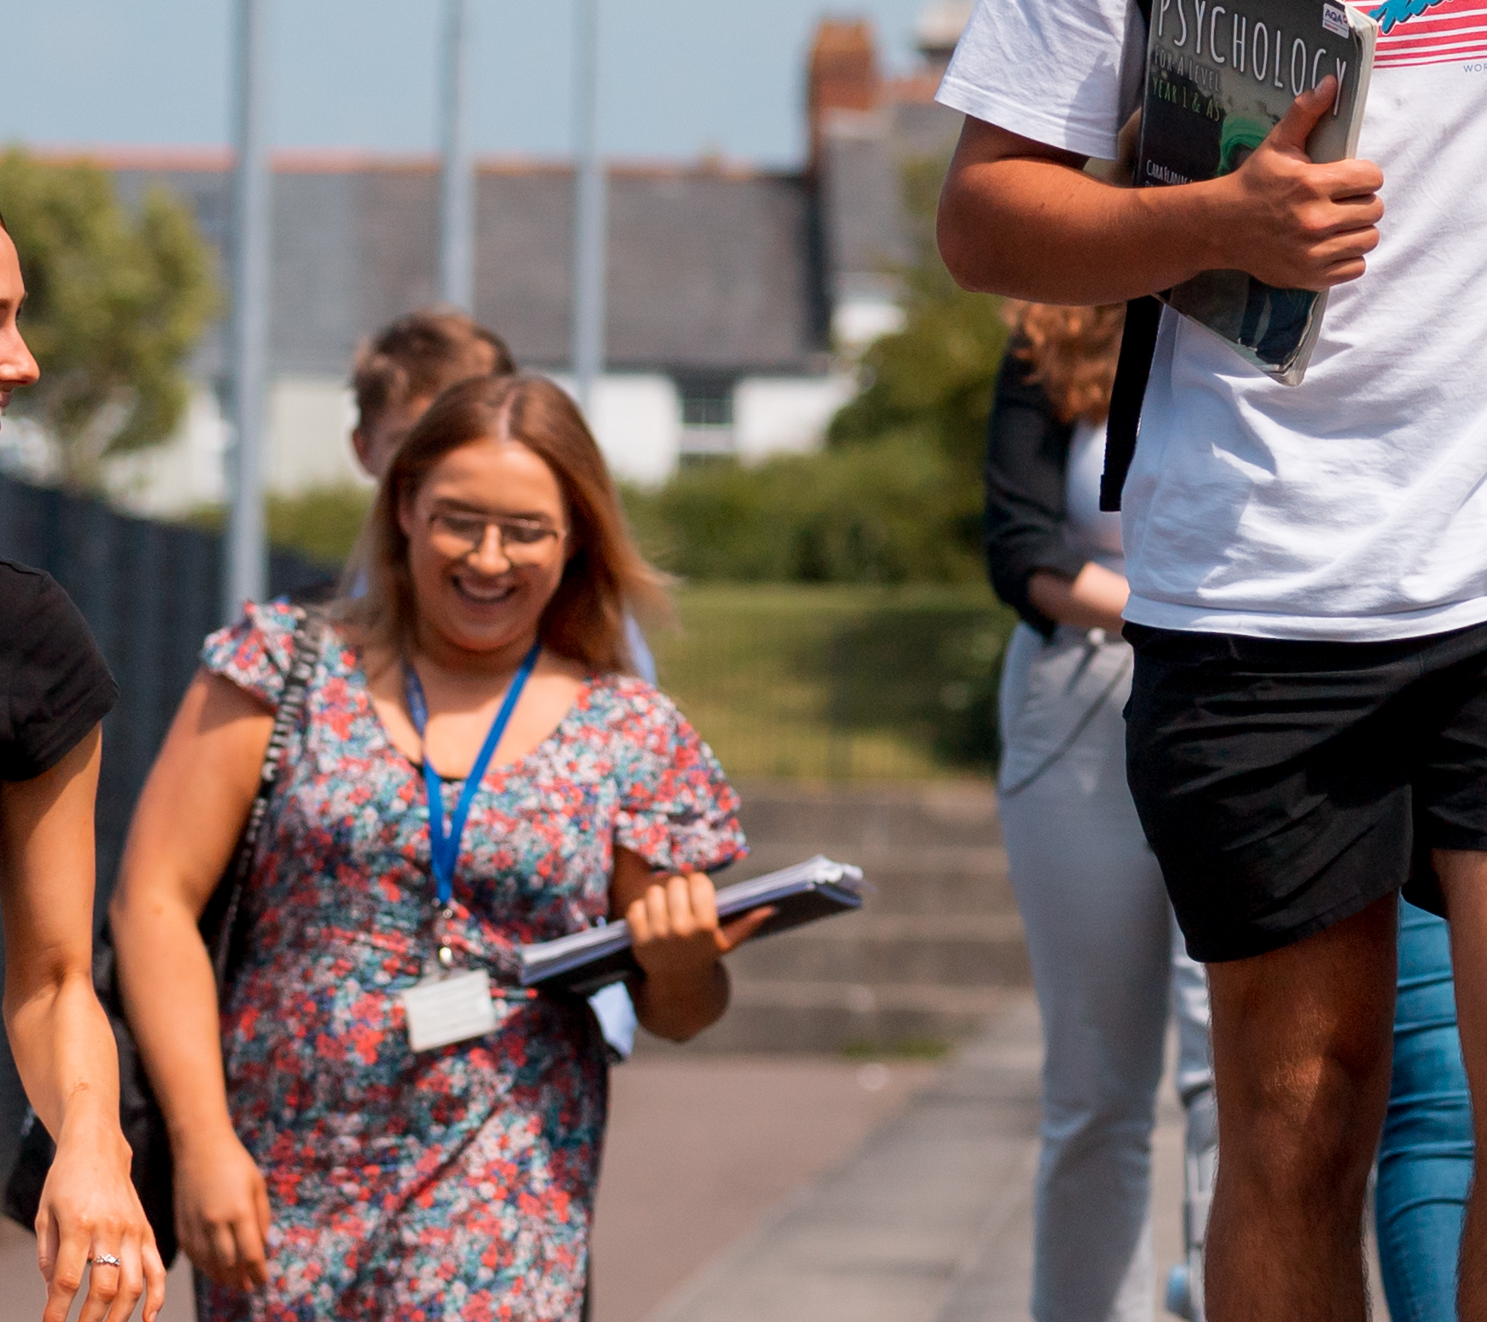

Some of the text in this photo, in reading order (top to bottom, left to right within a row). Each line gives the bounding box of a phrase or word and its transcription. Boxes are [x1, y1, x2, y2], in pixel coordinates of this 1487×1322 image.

[1325, 9, 1343, 25] AQA
[1155, 44, 1219, 92] FOR A LEVEL
[1153, 77, 1177, 104] YEAR
[1192, 92, 1201, 114] &
[1206, 99, 1220, 122] AS
